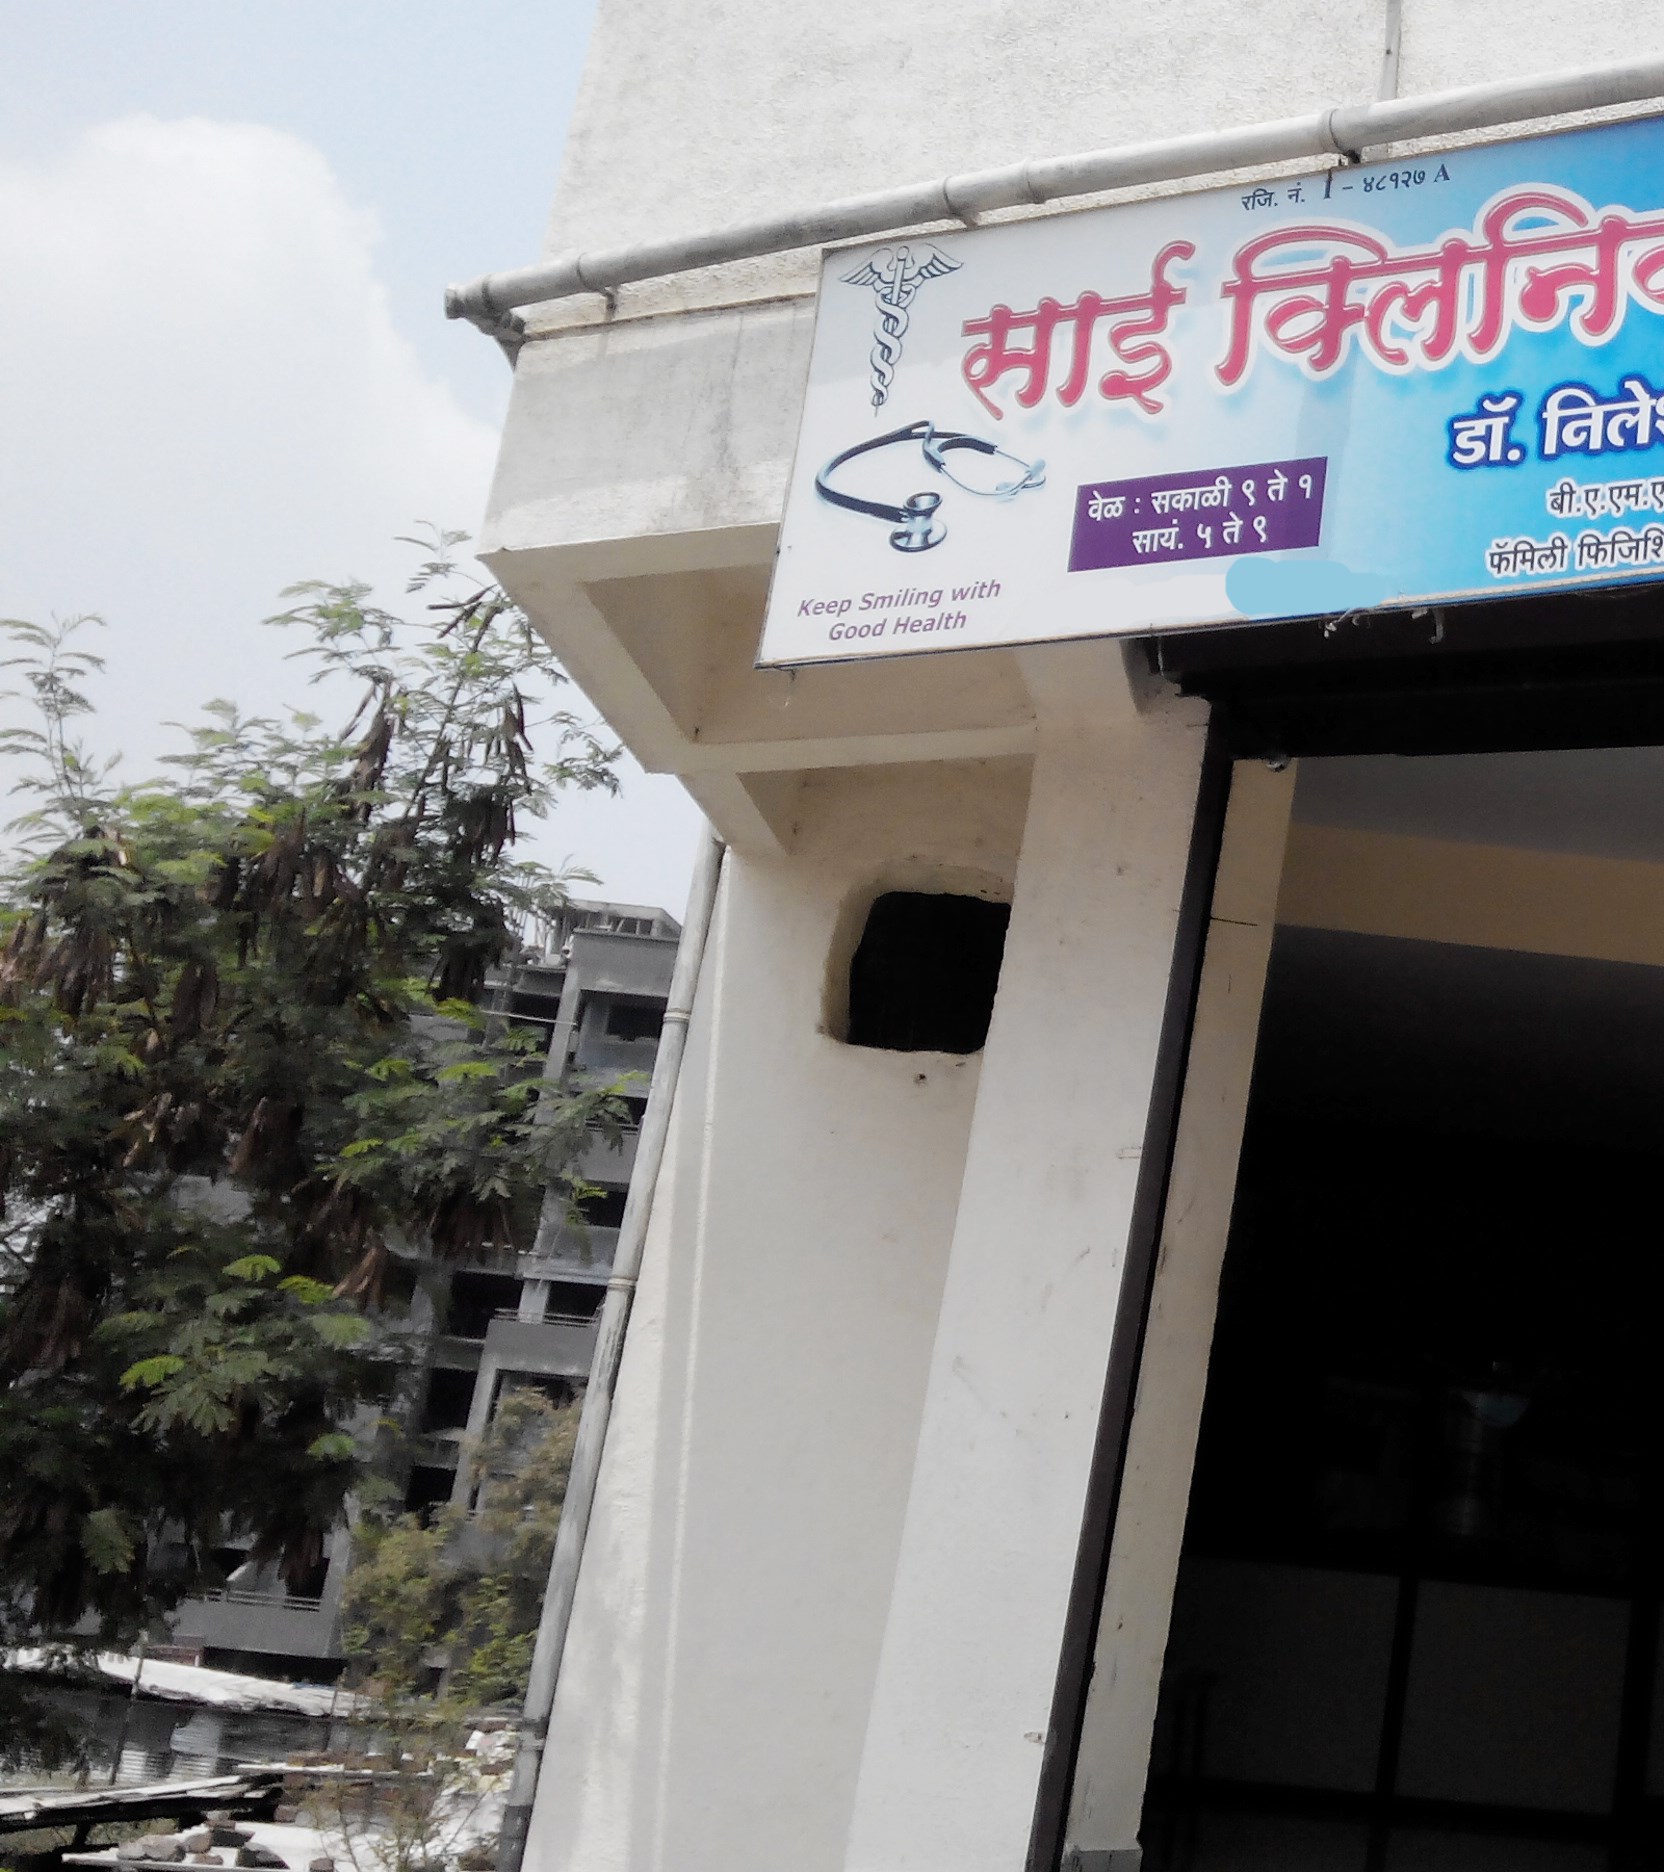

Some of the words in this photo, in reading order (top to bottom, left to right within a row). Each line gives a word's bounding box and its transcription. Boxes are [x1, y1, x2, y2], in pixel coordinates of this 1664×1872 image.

[1241, 188, 1278, 210] रजि.
[1287, 182, 1306, 203] नं.
[1362, 168, 1426, 193] ४८१२७
[1433, 163, 1451, 184] A
[960, 239, 1196, 421] साई
[1452, 396, 1522, 463] डॉ.
[1087, 490, 1125, 521] वेळ
[1133, 497, 1141, 514] :
[1150, 476, 1232, 514] सकाळी
[1241, 479, 1255, 506] ९
[1267, 469, 1288, 502] ते
[1298, 473, 1312, 499] १
[1132, 518, 1183, 553] सायं.
[1196, 522, 1212, 549] ५
[1222, 512, 1243, 544] ते
[1252, 515, 1267, 542] ९
[1488, 536, 1568, 574] फॅमिली
[797, 598, 852, 617] Keep
[858, 588, 943, 611] Smiling
[951, 579, 1001, 601] with
[828, 618, 887, 641] Good
[892, 611, 967, 635] Health
